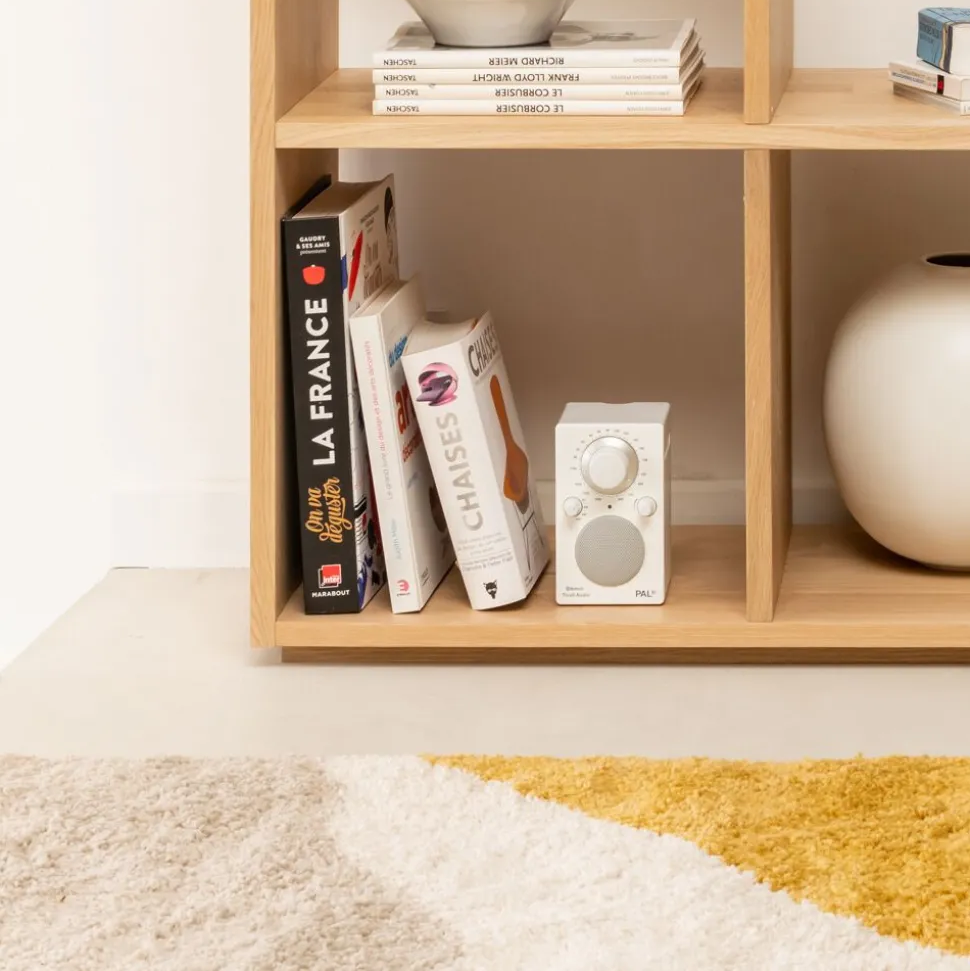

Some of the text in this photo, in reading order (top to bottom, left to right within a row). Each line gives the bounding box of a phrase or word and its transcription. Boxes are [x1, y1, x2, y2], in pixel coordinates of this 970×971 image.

[488, 57, 565, 66] RICHARD MEIER
[472, 73, 580, 82] FRANK LLOYD WRIGHT
[494, 88, 563, 97] LE CORBUSIER
[495, 104, 564, 113] LE CORBUSIER
[304, 298, 336, 465] LA FRANCE
[436, 412, 484, 531] CHAISES
[305, 487, 324, 532] On va
[311, 589, 350, 598] MARABOUT
